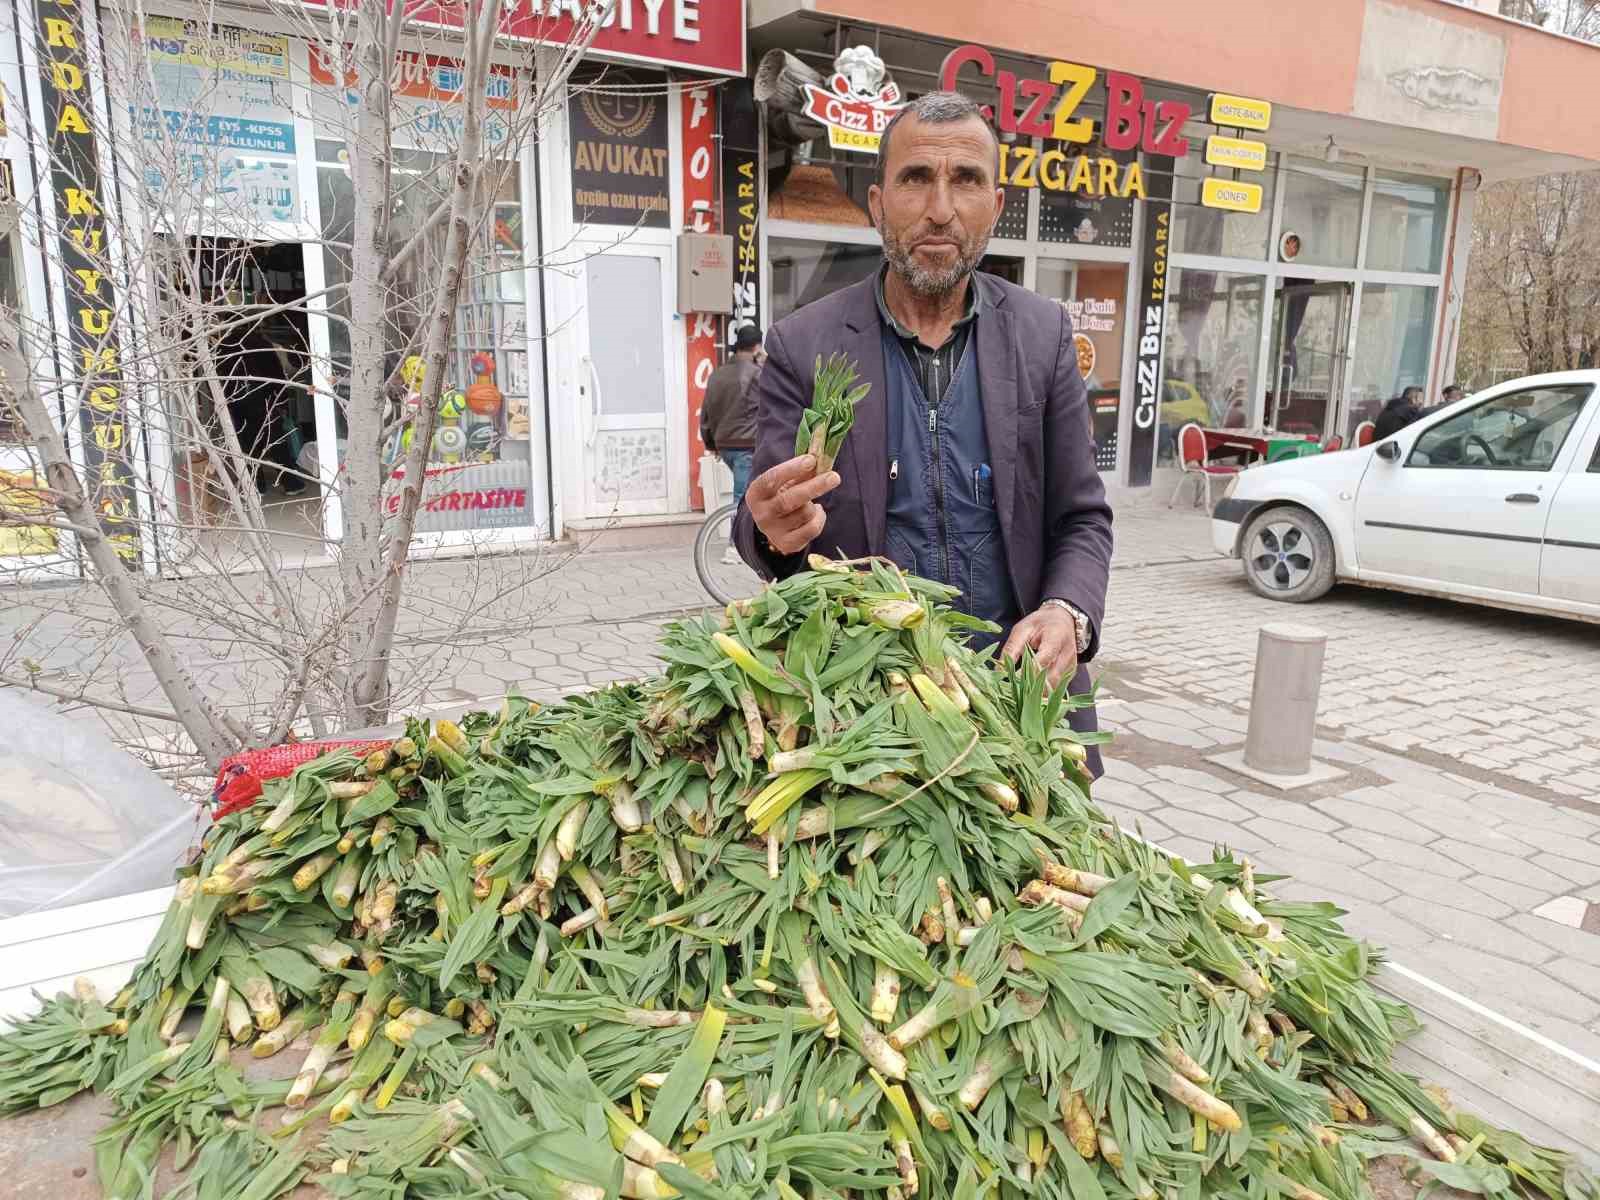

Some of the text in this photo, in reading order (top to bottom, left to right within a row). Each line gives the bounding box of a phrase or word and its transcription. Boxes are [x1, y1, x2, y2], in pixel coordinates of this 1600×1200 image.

[41, 0, 92, 134] RDA
[575, 140, 669, 177] AVUKAT
[999, 143, 1147, 200] IZGARA
[1152, 211, 1169, 301] IZGARA
